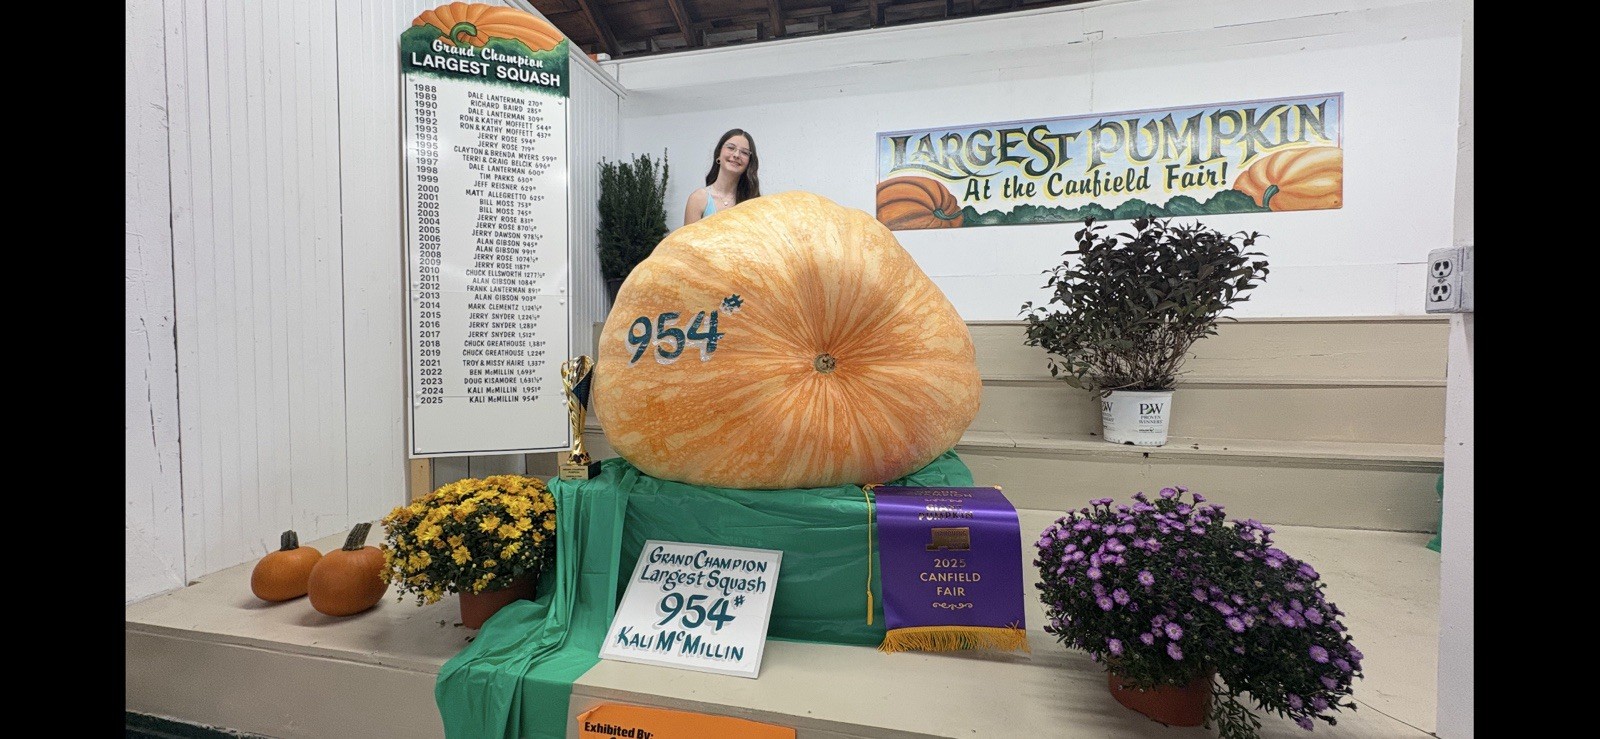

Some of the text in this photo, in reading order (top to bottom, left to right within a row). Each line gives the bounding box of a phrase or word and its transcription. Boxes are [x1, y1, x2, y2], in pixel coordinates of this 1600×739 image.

[432, 40, 543, 68] Grand Champion
[412, 52, 560, 86] LARGEST SQUASH
[414, 84, 524, 104] 1988 DALE LANTERMAN
[415, 92, 523, 112] 1989 RICHARD BAIRD
[415, 100, 525, 120] 1990 DALE LANTERMAN
[415, 108, 436, 117] 1991
[481, 117, 502, 125] KATHY
[506, 120, 533, 129] MOFFETT
[415, 116, 437, 125] 1992
[482, 125, 502, 133] KATHY
[506, 128, 533, 137] MOFFETT
[415, 125, 438, 133] 1993
[416, 133, 438, 141] 1994
[888, 98, 1331, 179] LARGEST PUMPKIN
[416, 141, 438, 149] 1995
[454, 146, 483, 155] CLAYTON
[490, 150, 515, 158] BRENDA
[416, 149, 438, 157] 1996
[489, 157, 508, 165] CRAIG
[416, 157, 438, 165] 1997
[488, 165, 525, 174] LANTERMAN
[416, 166, 438, 174] 1998
[417, 175, 438, 183] 1999
[491, 182, 517, 190] REISNER
[964, 163, 1227, 202] At the Canfield Fair!
[418, 184, 439, 193] 2000
[488, 191, 526, 200] ALLEGRETTO
[418, 192, 438, 200] 2001
[418, 201, 439, 209] 2002
[418, 209, 439, 217] 2003
[419, 226, 440, 234] 2005
[419, 234, 440, 242] 2006
[918, 510, 973, 520] PUMPKIN
[650, 546, 767, 572] GRAND CHAMPION
[934, 558, 966, 567] 2025
[641, 564, 766, 596] Largest Squash
[920, 572, 981, 582] CANFIELD
[937, 587, 965, 596] FAIR
[618, 626, 654, 649] KALI
[584, 722, 654, 739] Exhibited By:
